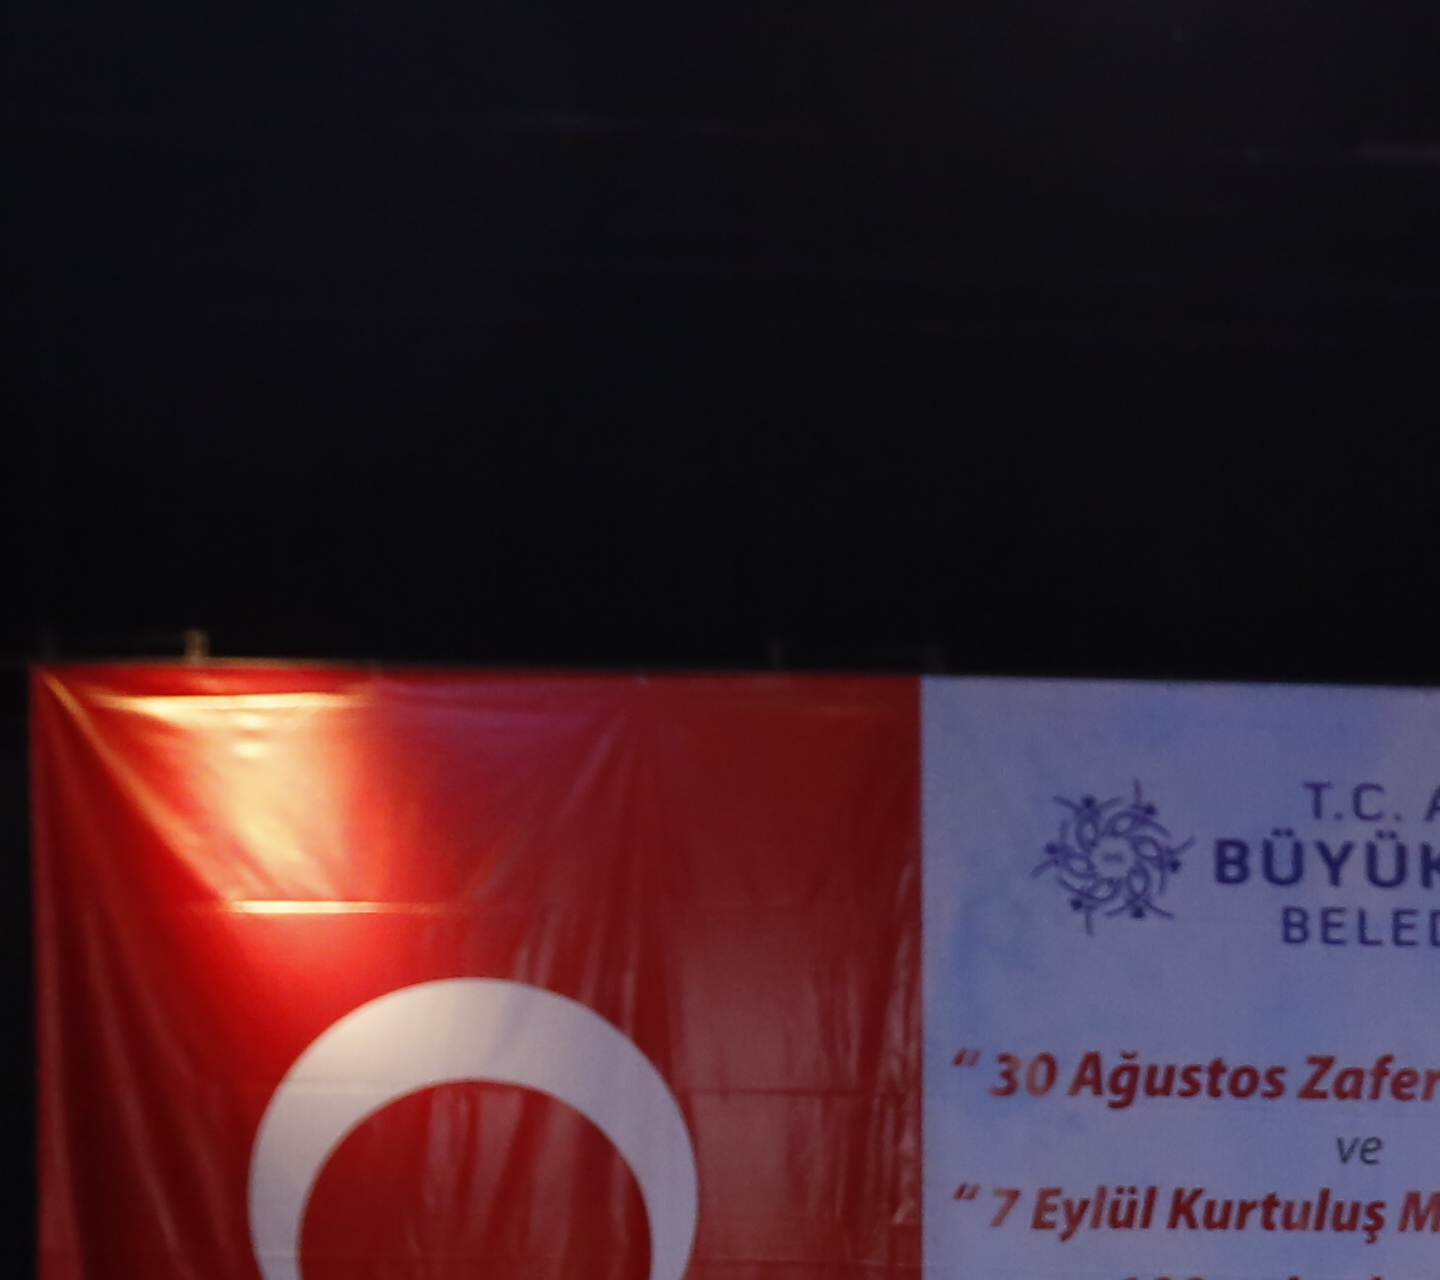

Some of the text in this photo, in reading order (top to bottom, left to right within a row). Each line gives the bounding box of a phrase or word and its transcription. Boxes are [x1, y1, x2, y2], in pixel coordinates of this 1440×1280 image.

[1302, 781, 1403, 823] T.C.
[1067, 1051, 1287, 1110] Ağustos
[1336, 1136, 1384, 1166] ve
[1030, 1185, 1158, 1243] Eylül
[1166, 1187, 1387, 1245] Kurtuluş
